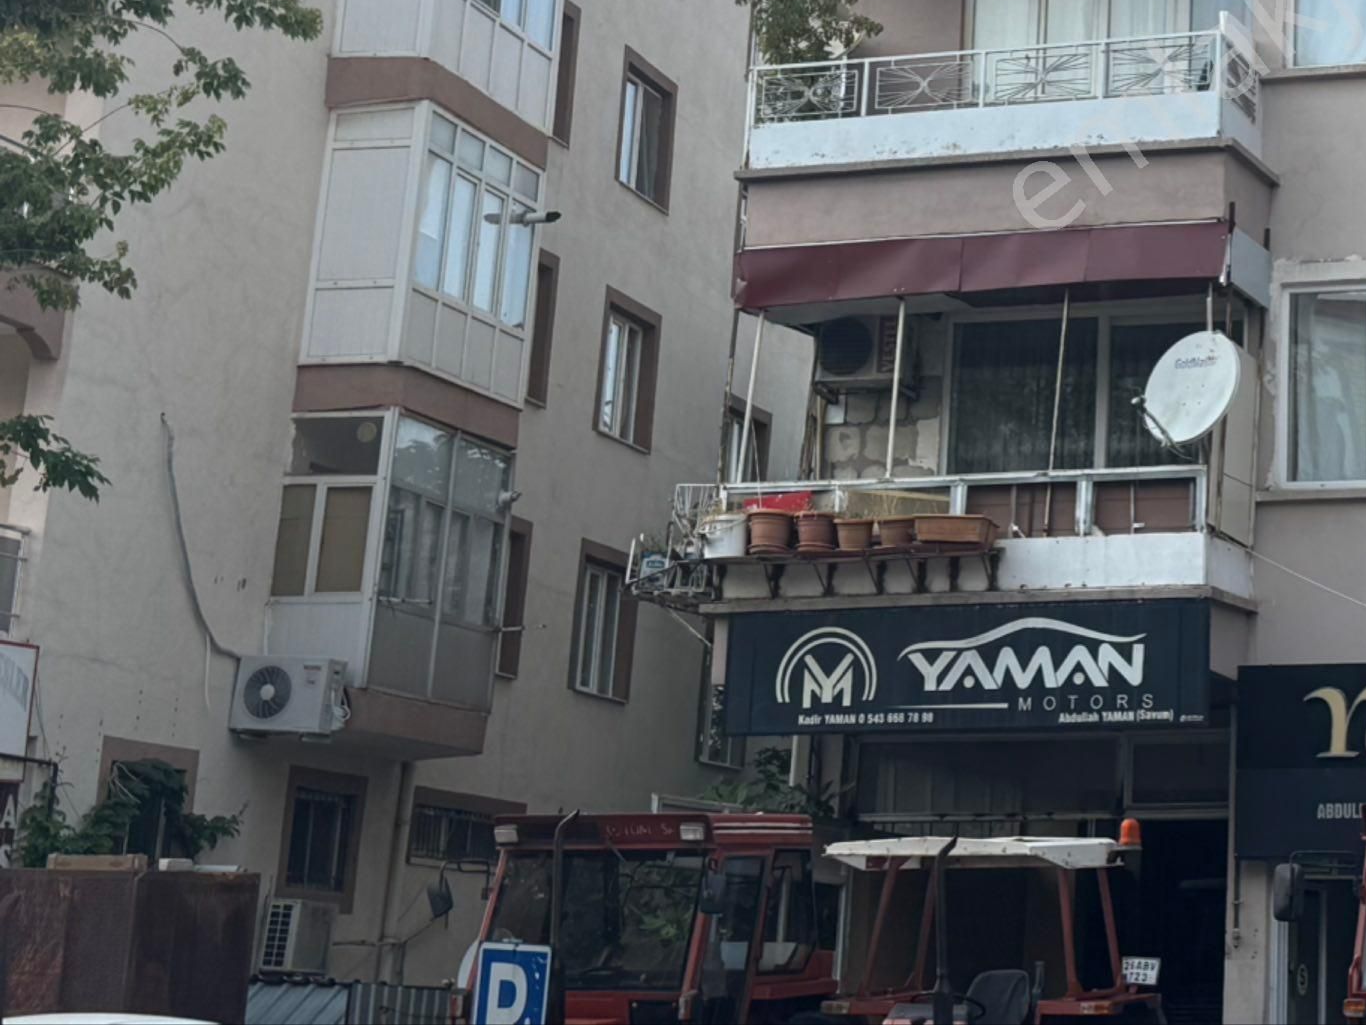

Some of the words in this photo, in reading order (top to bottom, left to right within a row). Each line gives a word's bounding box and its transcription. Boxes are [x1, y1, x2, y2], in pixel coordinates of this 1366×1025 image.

[907, 643, 1145, 691] YAMAN
[1018, 694, 1154, 711] MOTORS
[824, 713, 856, 724] YAMAN
[858, 713, 865, 723] 0
[1058, 712, 1099, 723] Abdullah
[1101, 711, 1134, 722] YAMAN
